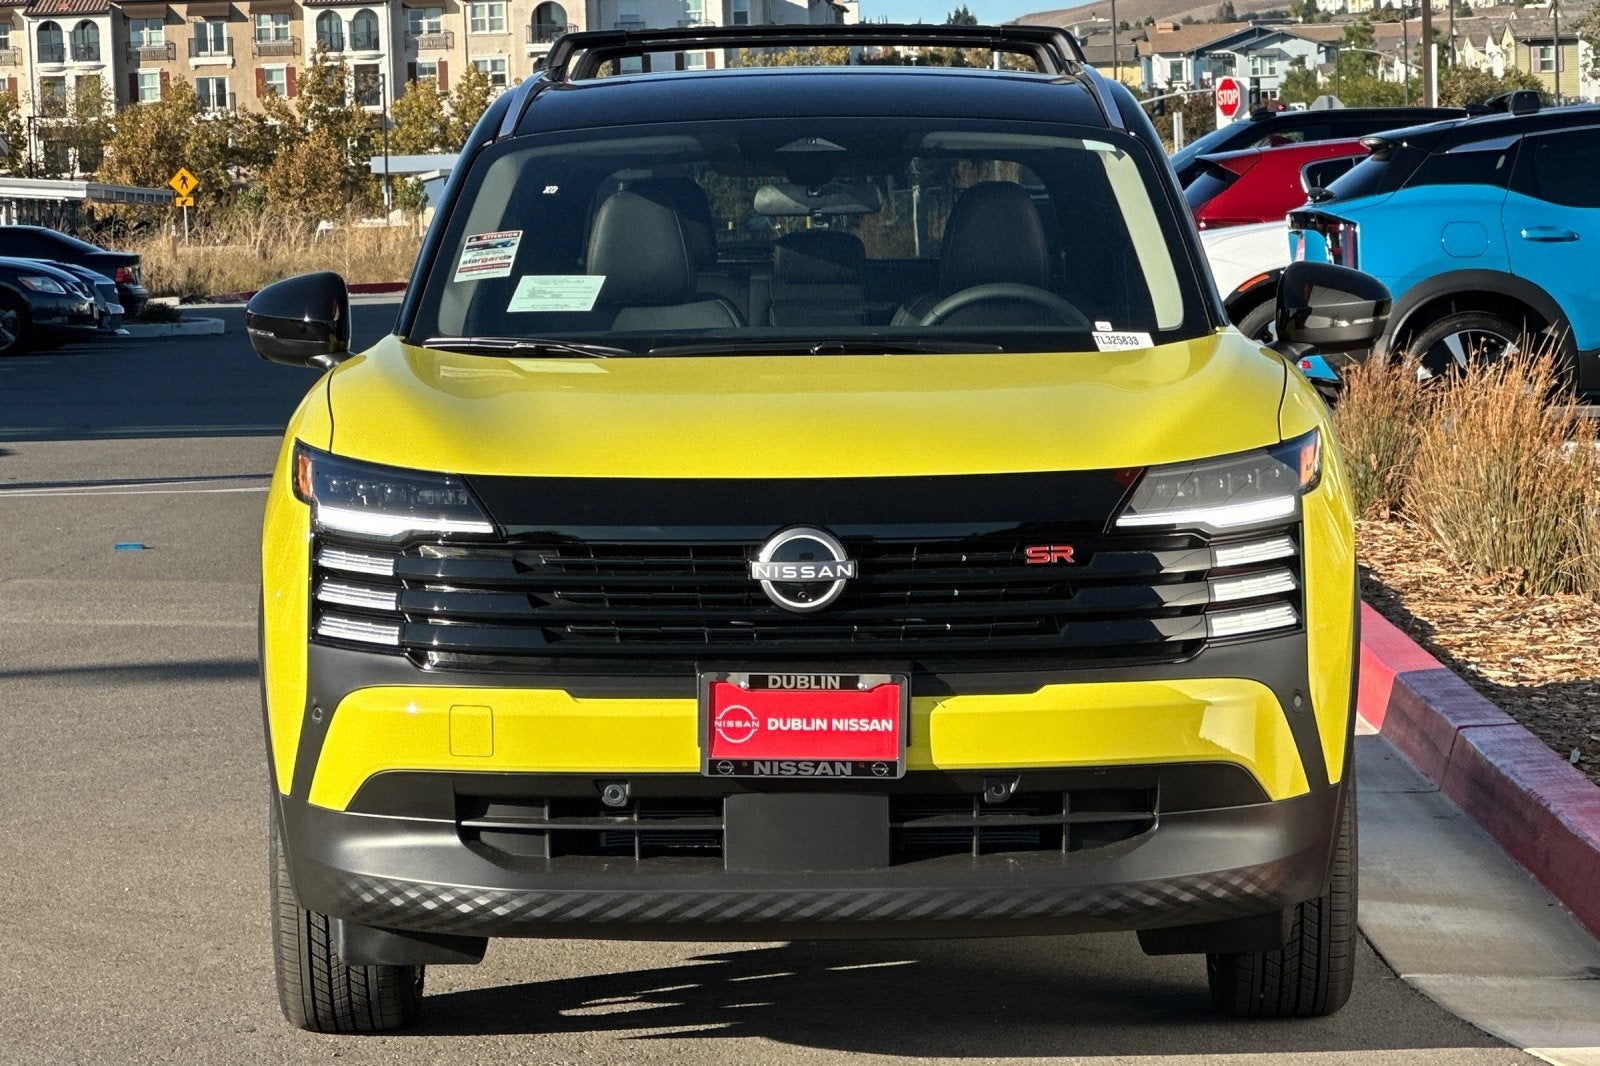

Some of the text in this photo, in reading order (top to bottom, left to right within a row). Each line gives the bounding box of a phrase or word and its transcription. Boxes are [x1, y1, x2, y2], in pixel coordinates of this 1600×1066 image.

[1218, 89, 1238, 105] STOP
[482, 232, 518, 240] ATTENTION
[1094, 335, 1139, 345] TL325833
[1024, 544, 1075, 564] SR
[753, 563, 853, 579] NISSAN
[767, 674, 841, 690] DUBLIN
[714, 720, 760, 728] NISSAN
[767, 717, 894, 732] DUBLIN NISSAN
[753, 760, 853, 776] NISSAN
